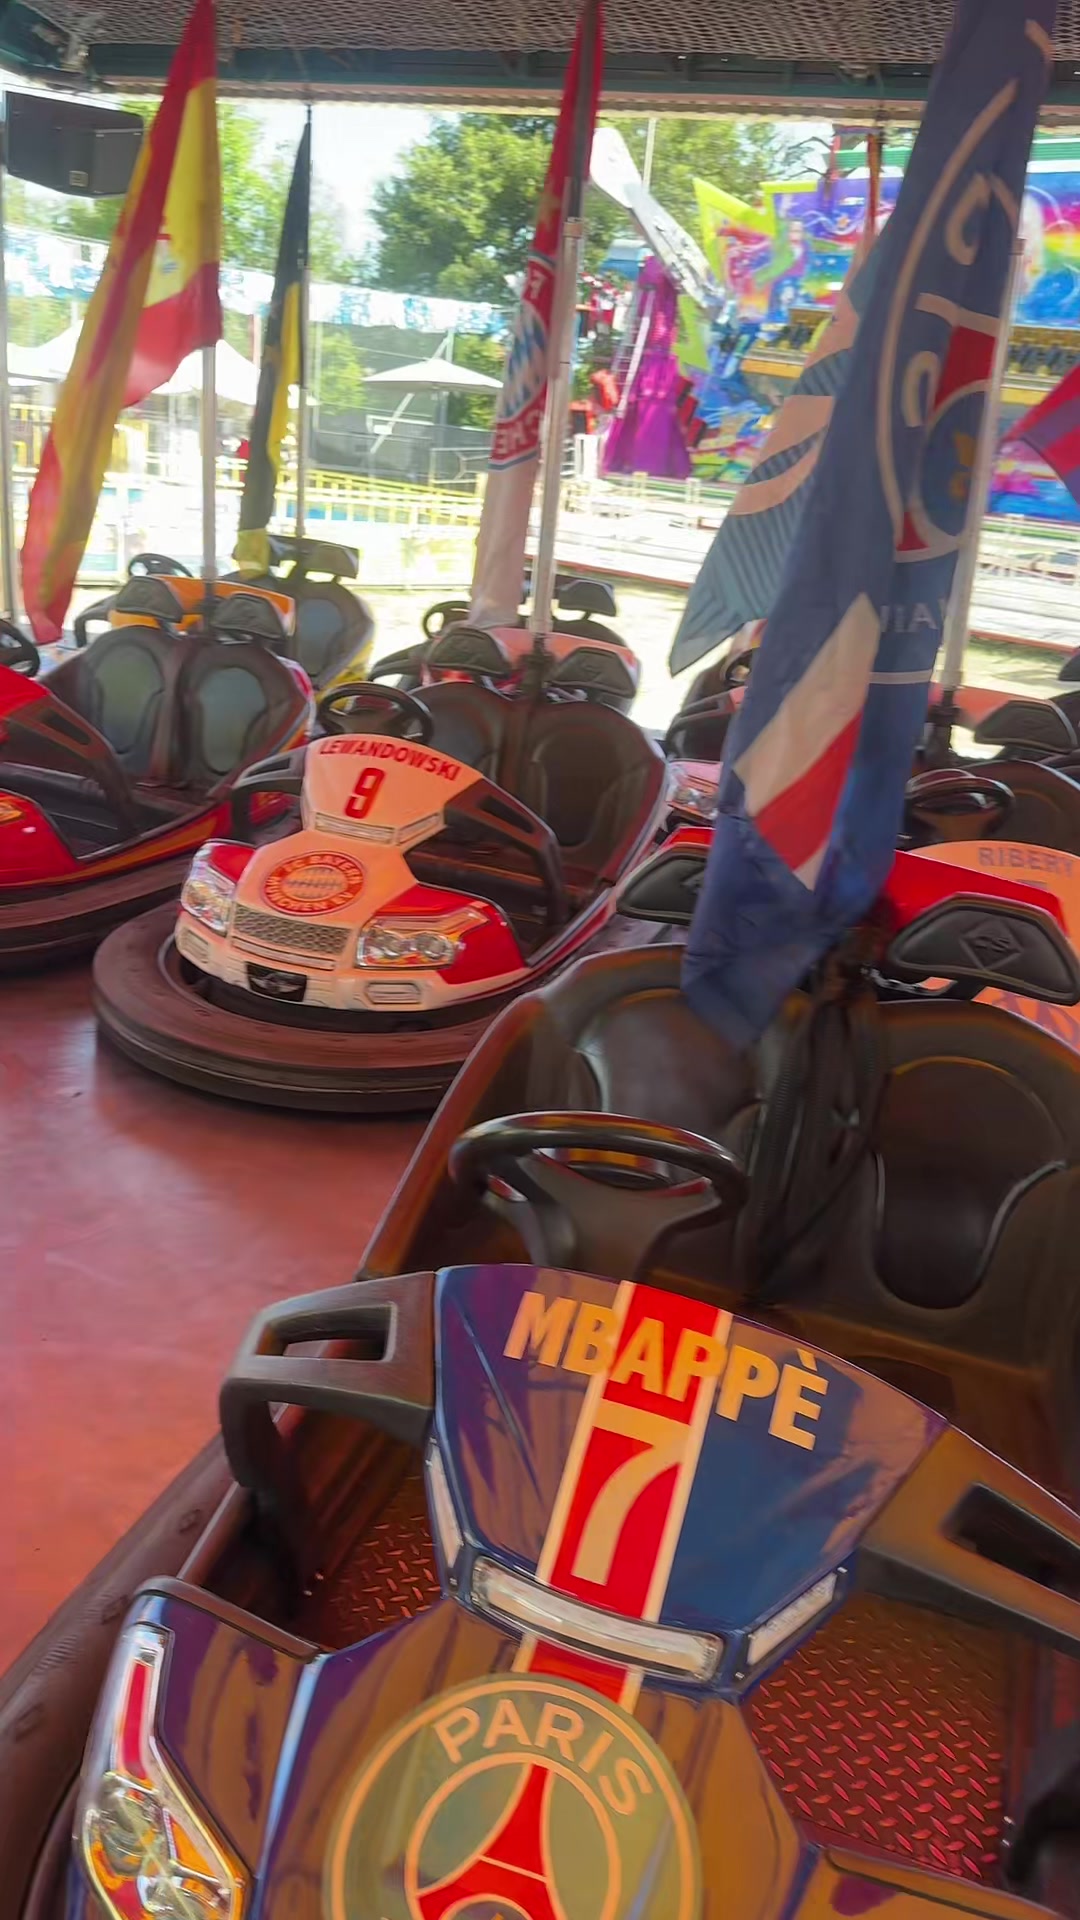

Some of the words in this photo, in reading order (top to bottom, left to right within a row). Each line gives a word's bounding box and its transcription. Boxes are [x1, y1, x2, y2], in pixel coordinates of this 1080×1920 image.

[320, 740, 461, 781] LEWANDOWSKI
[345, 767, 385, 819] 9
[979, 847, 1073, 878] RIBERY
[571, 1398, 692, 1586] 7
[434, 1698, 653, 1816] PARIS
